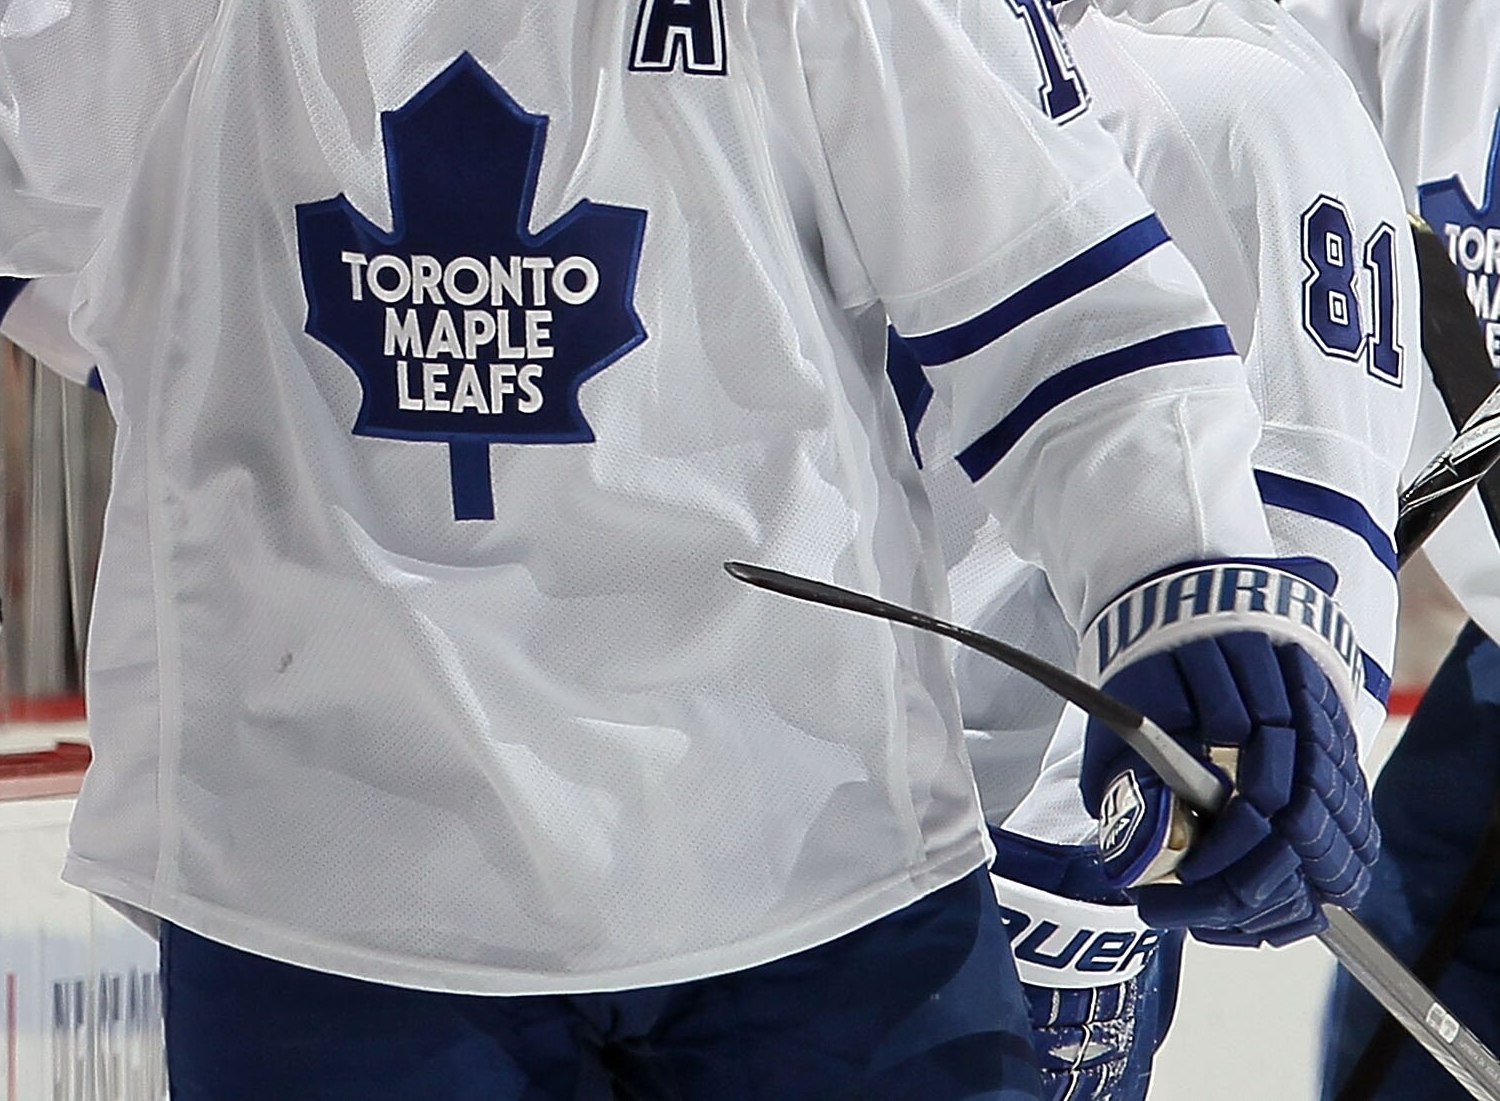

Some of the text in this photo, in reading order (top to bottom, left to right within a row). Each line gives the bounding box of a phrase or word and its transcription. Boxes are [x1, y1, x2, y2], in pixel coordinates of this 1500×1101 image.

[341, 252, 599, 304] TORONTO
[1301, 194, 1405, 388] 81
[383, 308, 555, 359] MAPLE
[395, 361, 545, 414] LEAFS
